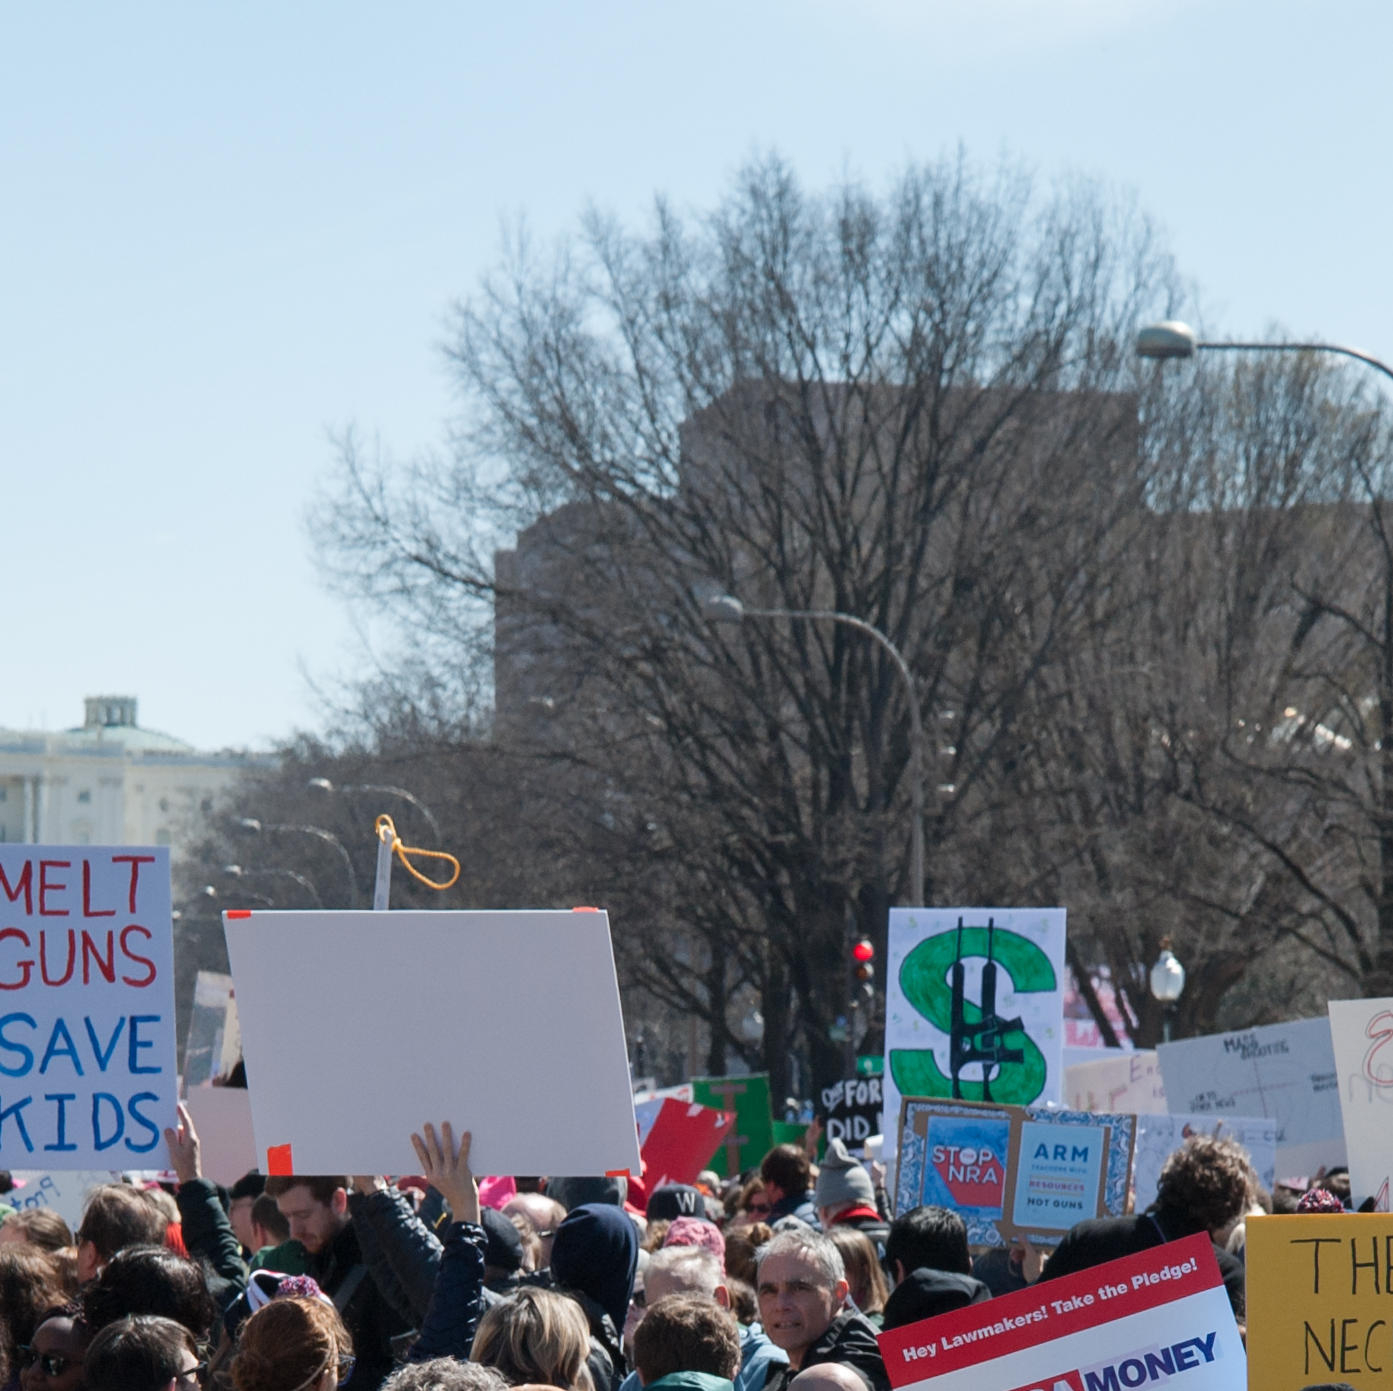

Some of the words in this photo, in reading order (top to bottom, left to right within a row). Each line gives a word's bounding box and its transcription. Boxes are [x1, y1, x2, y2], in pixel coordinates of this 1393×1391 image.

[844, 1078, 885, 1105] FOR
[826, 1117, 870, 1145] DID
[932, 1145, 994, 1166] STOP
[1033, 1142, 1090, 1163] ARM
[948, 1165, 999, 1185] NRA
[1029, 1180, 1085, 1192] RESOURCES
[675, 1192, 696, 1214] W
[1027, 1197, 1050, 1207] NOT
[1052, 1198, 1084, 1210] GUNS
[902, 1341, 938, 1363] Hey
[940, 1305, 1049, 1351] Lawmakers!
[1050, 1291, 1096, 1316] Take
[1097, 1281, 1128, 1303] the
[1130, 1257, 1198, 1291] Pledge!
